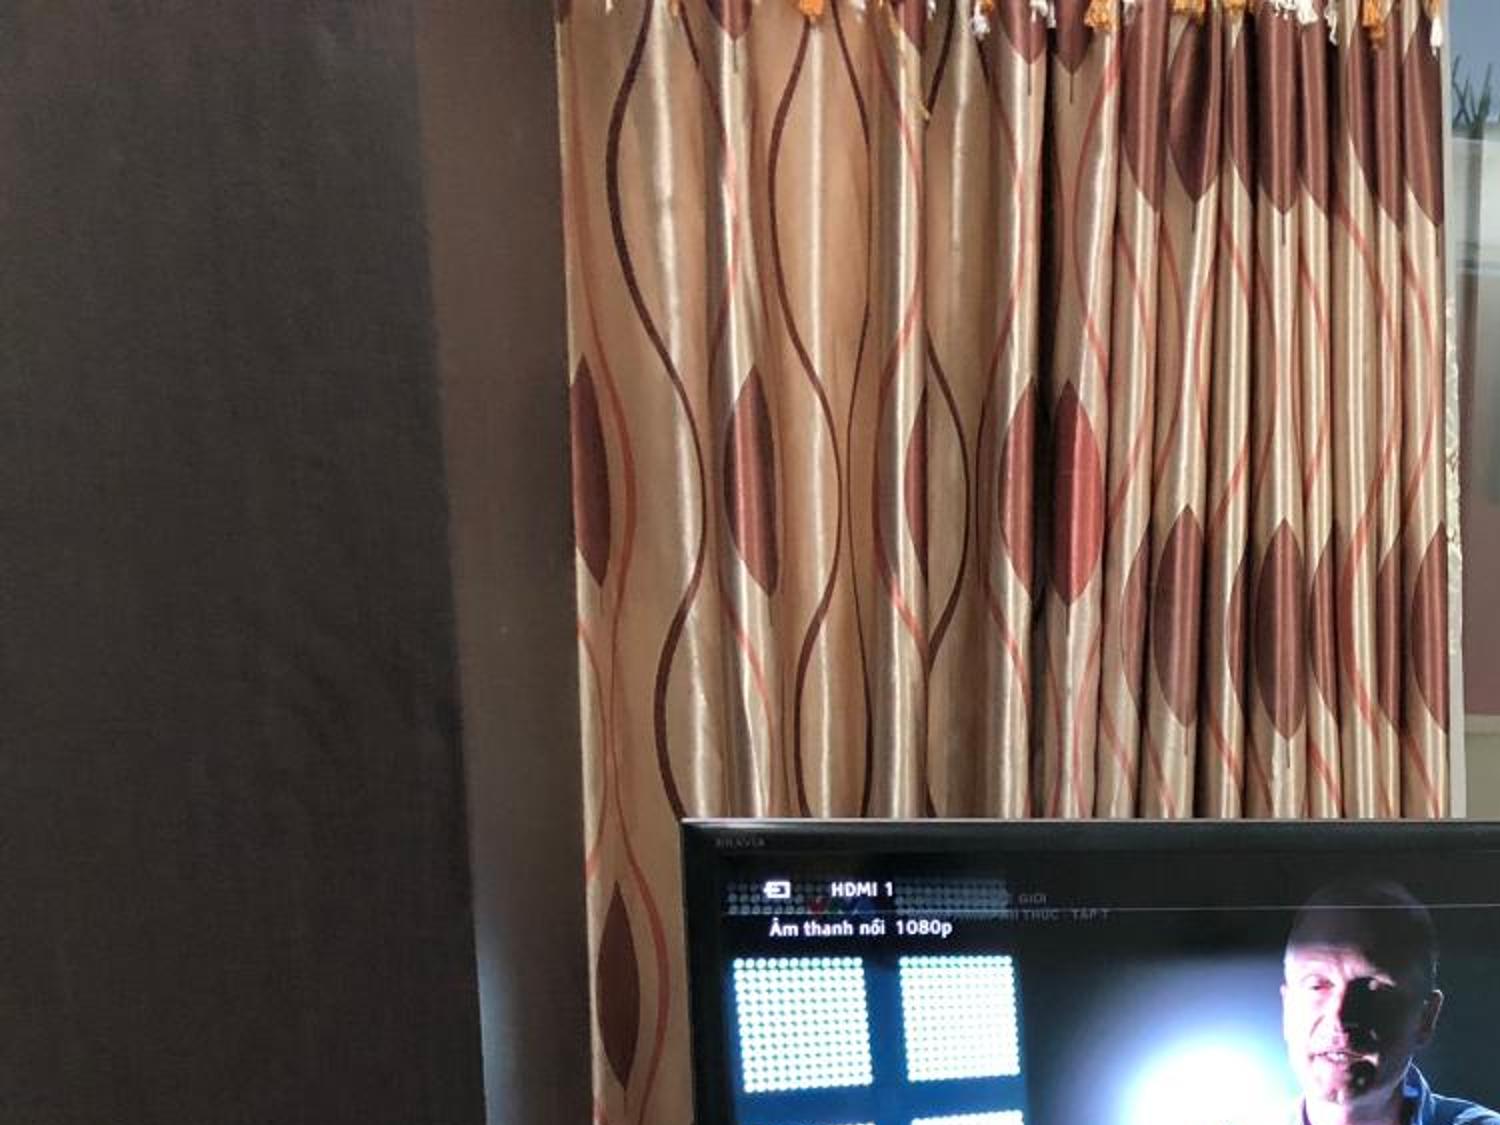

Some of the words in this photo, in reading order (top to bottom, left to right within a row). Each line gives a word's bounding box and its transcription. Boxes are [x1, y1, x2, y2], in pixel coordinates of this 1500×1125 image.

[831, 881, 878, 897] HDMI
[884, 881, 893, 897] 1
[803, 920, 853, 936] thanh
[896, 919, 953, 938] 1080p
